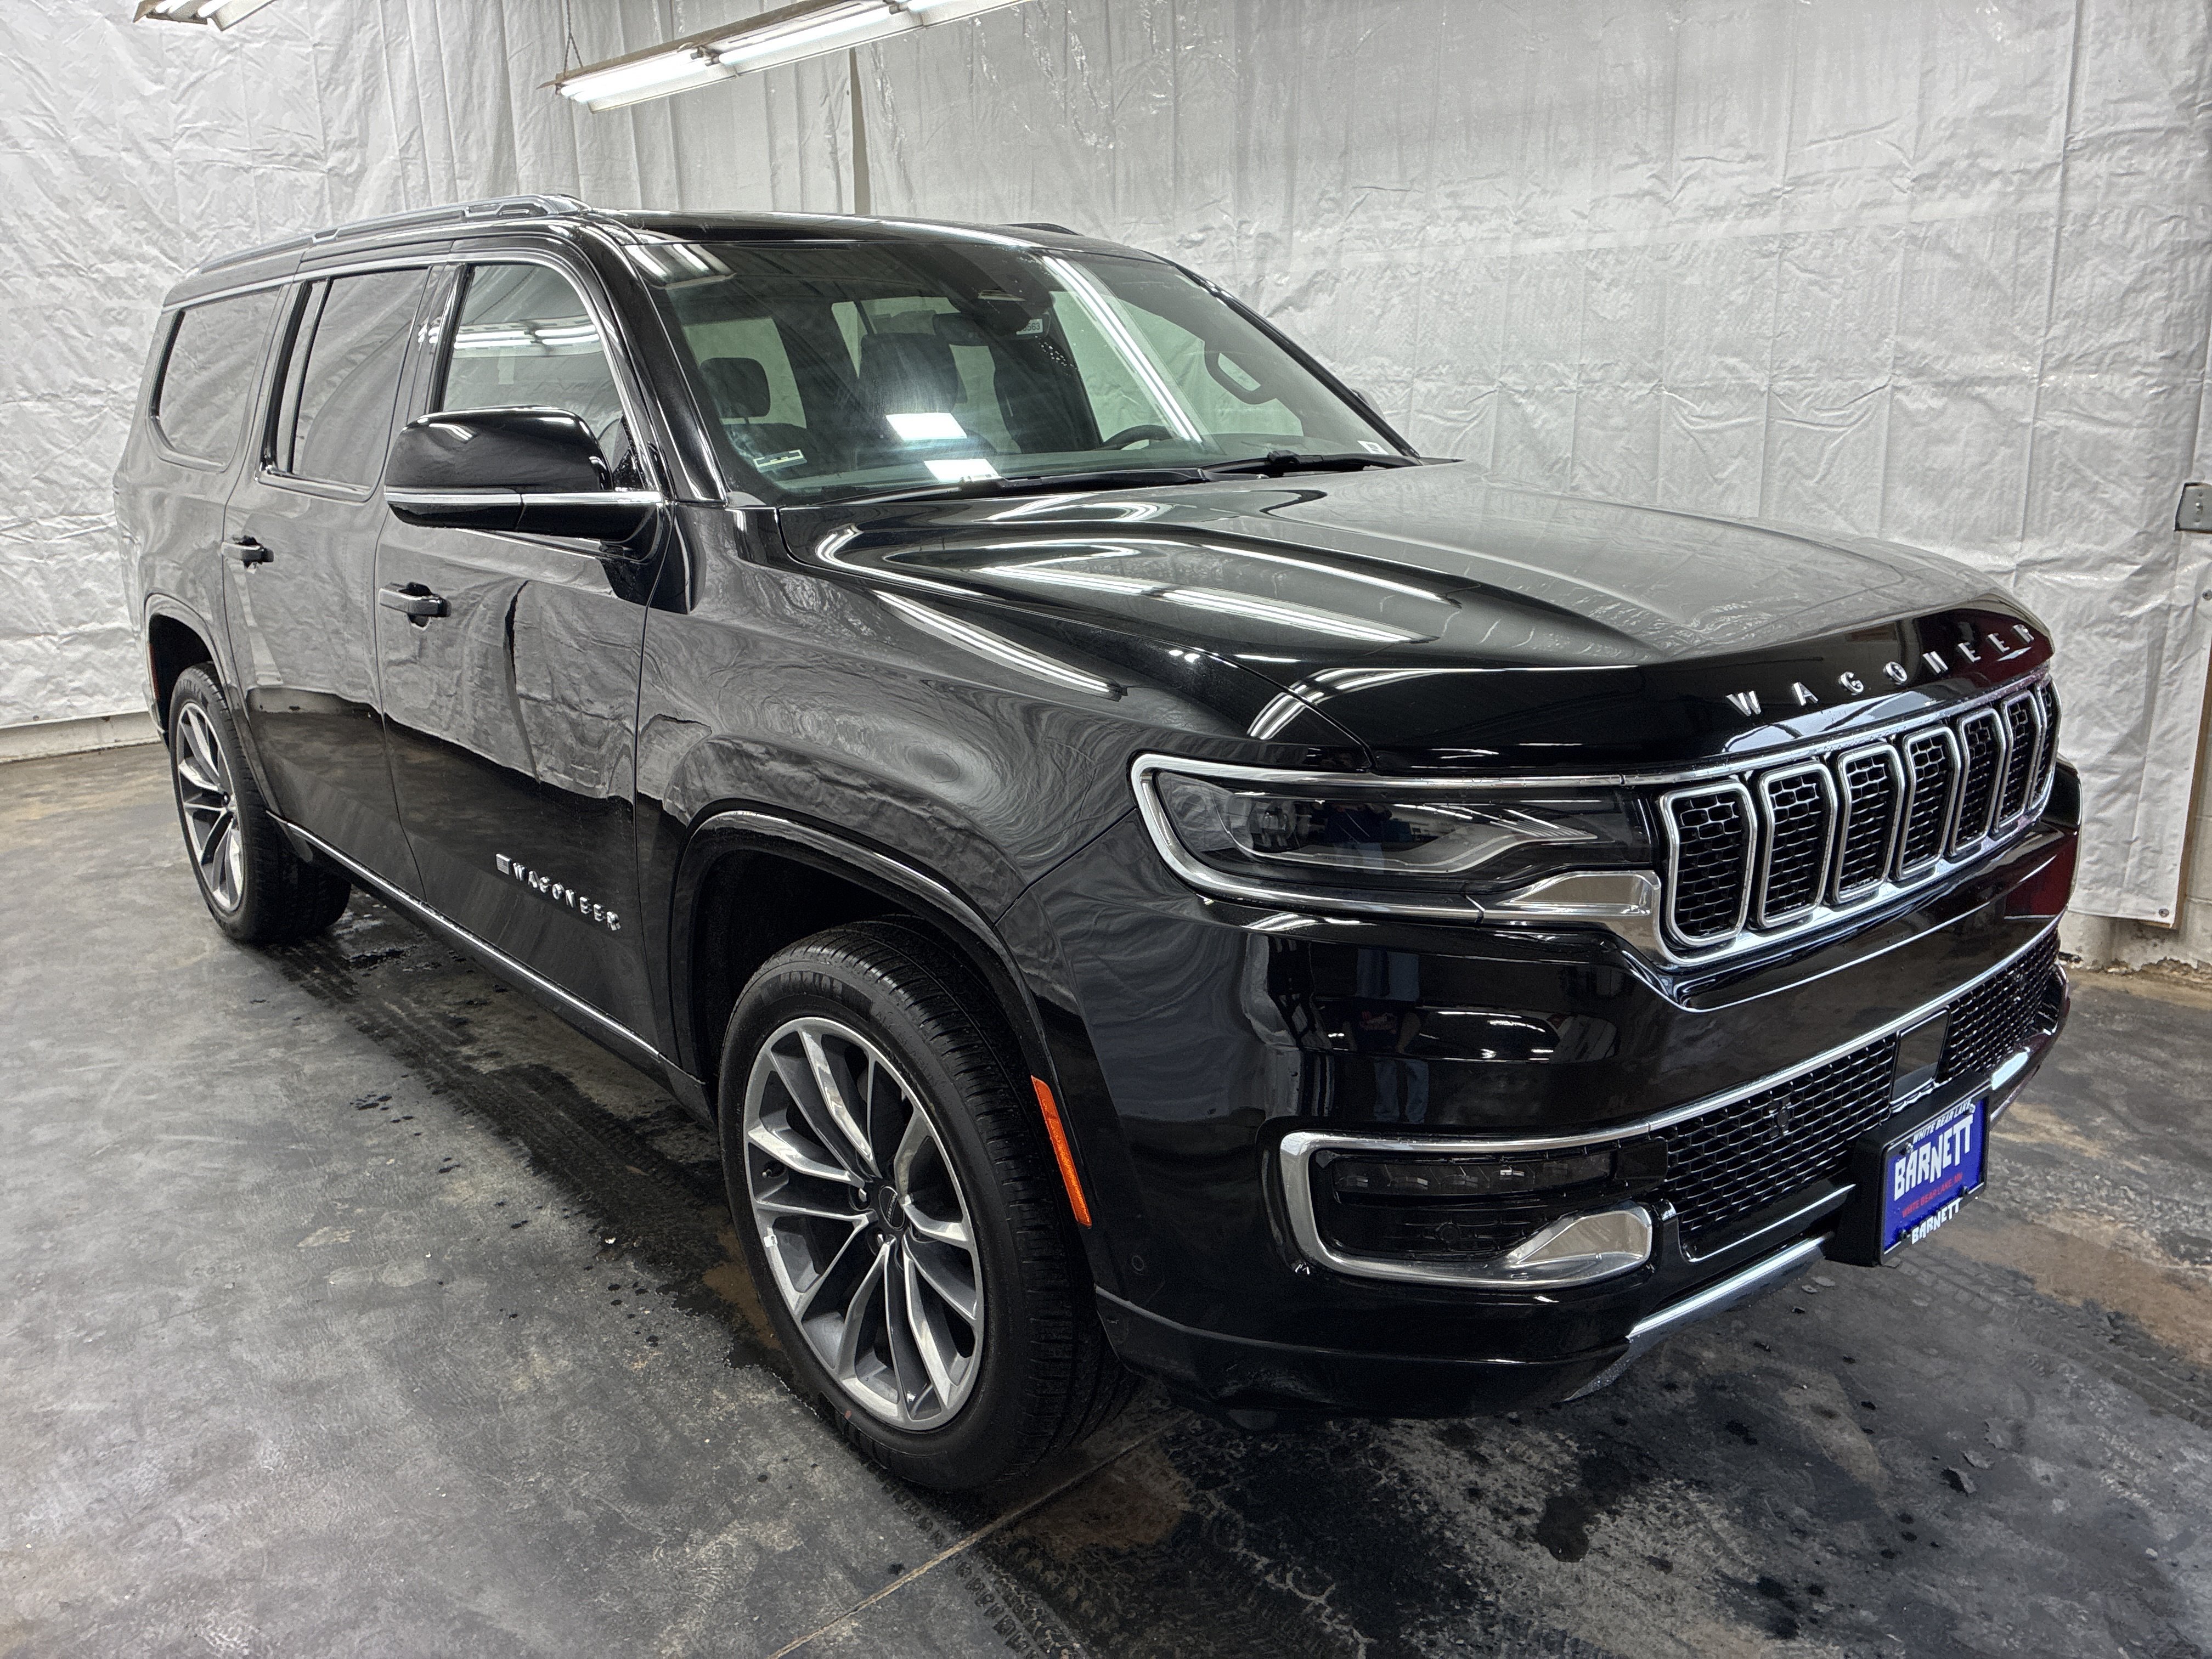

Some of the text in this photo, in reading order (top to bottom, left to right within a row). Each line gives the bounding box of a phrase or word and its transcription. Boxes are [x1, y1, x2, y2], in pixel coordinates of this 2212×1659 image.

[1726, 623, 2035, 717] WAGONEER
[512, 862, 621, 931] WAGONEER
[1912, 1099, 1972, 1144] WHITE BEAR LAKE
[1894, 1114, 1973, 1201] BARNETT
[1901, 1199, 1920, 1218] WHITE
[1920, 1188, 1938, 1206] BEAR
[1911, 1197, 1963, 1245] BARNETT
